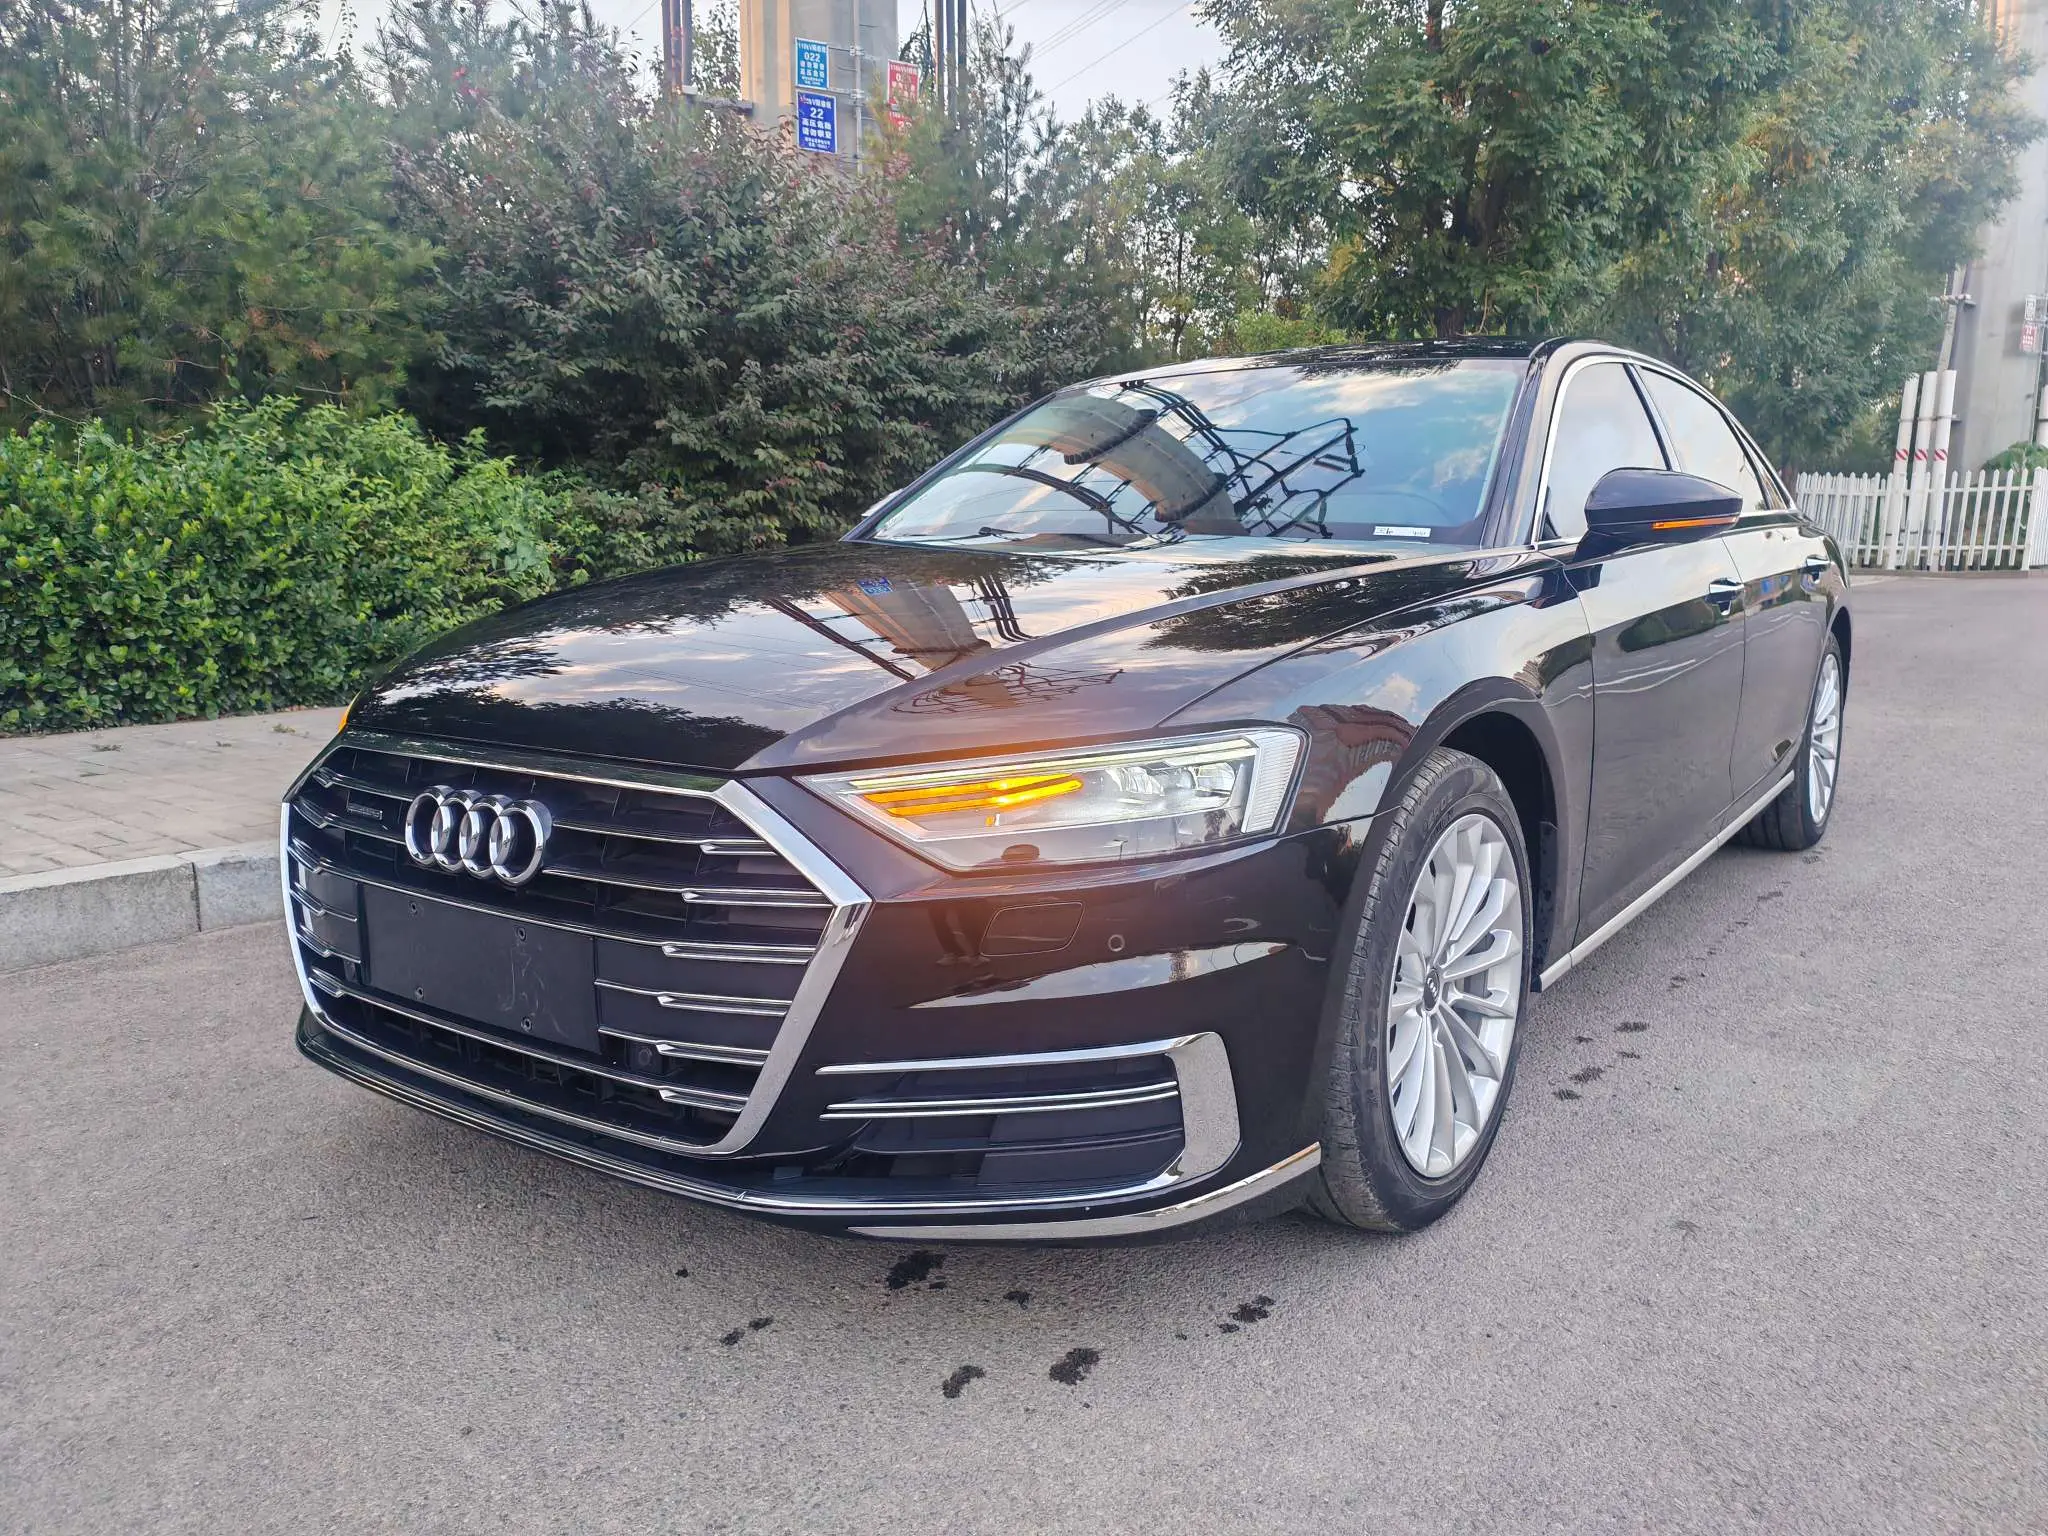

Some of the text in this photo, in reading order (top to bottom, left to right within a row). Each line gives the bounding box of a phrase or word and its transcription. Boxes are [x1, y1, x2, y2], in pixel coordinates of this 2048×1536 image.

[804, 51, 821, 62] 022
[809, 107, 824, 120] 22
[801, 117, 832, 130] 高压危险
